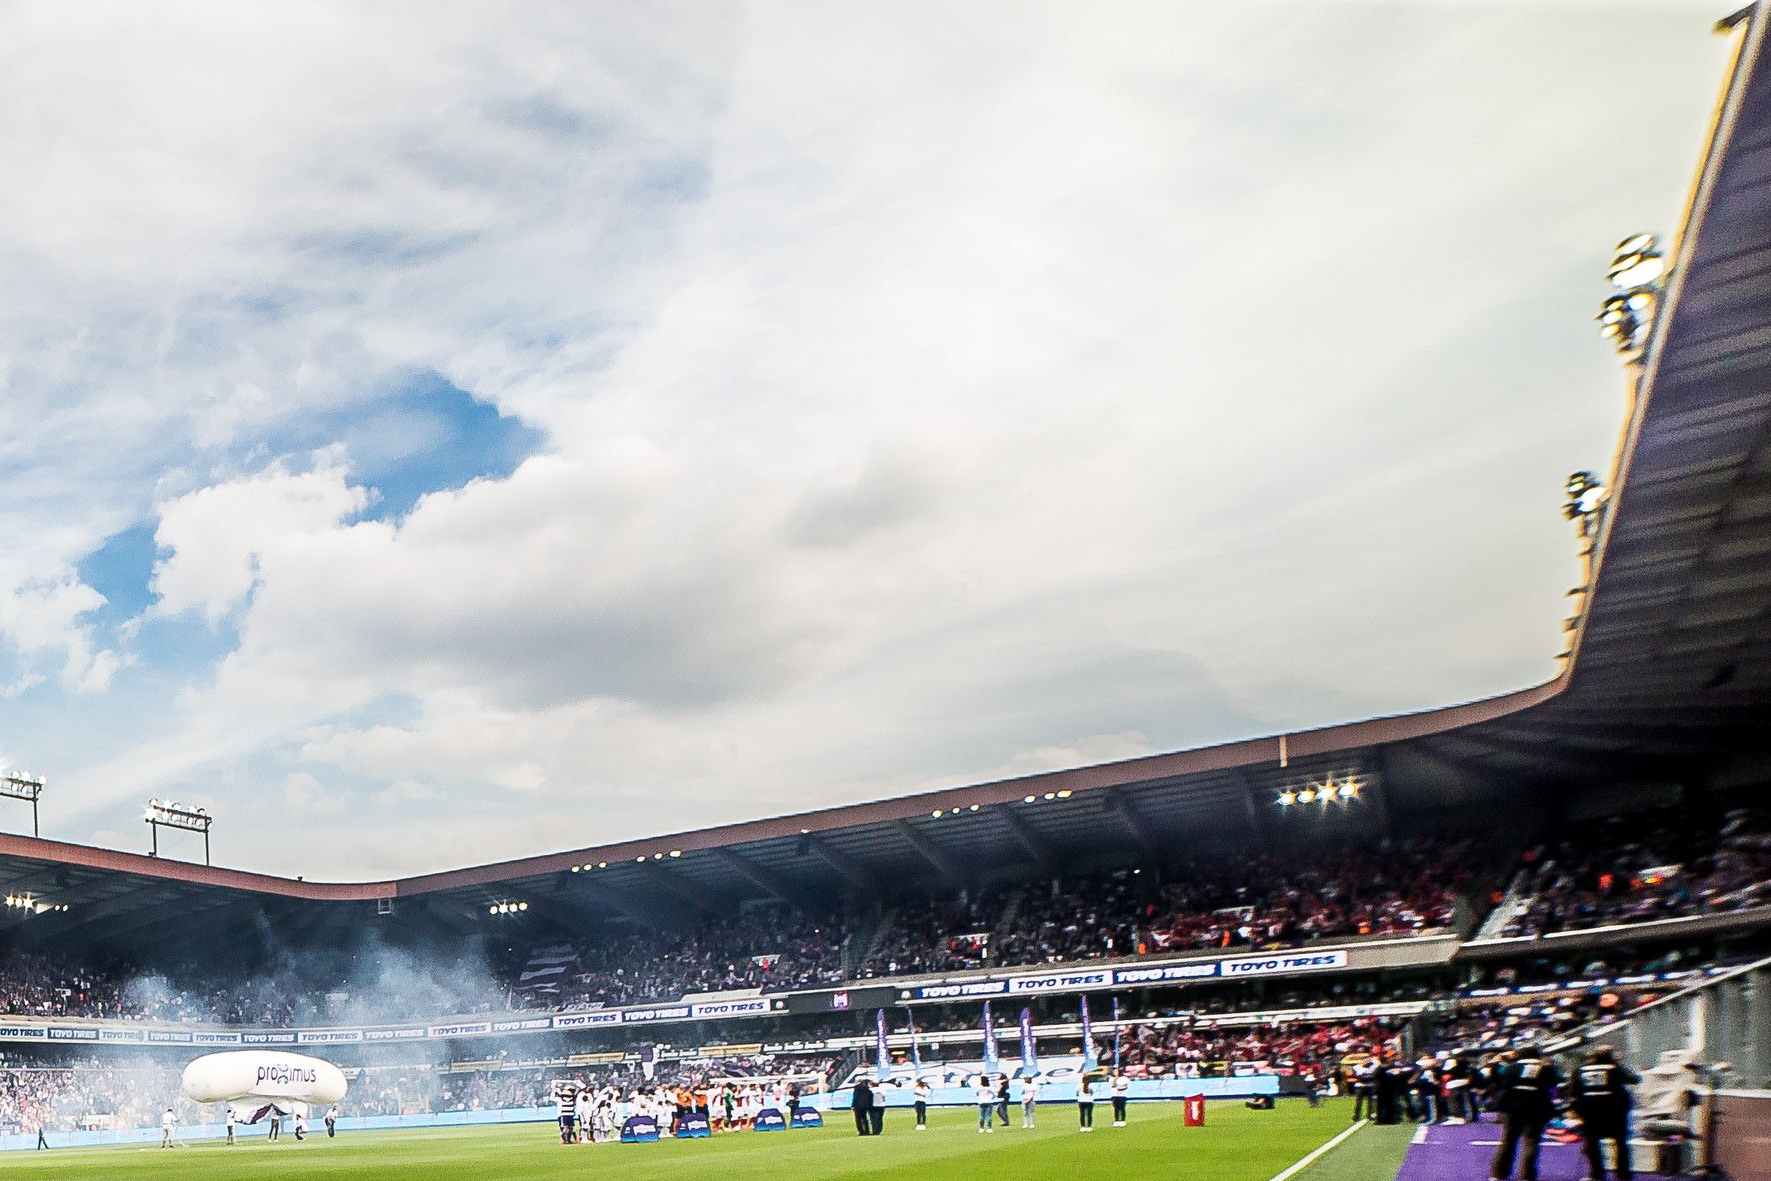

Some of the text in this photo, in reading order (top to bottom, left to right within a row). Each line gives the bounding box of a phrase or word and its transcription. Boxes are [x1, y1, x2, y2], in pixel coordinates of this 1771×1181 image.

[1231, 955, 1336, 973] TOYO TIRES
[1116, 968, 1164, 982] TOYO
[1018, 974, 1104, 989] TOYO TIRES
[921, 984, 960, 998] TOYO
[698, 1002, 764, 1014] TOYO TIRES
[558, 1014, 617, 1025] TOYO TIRES
[624, 1010, 654, 1021] TOYO
[432, 1025, 487, 1035] TOYO TIRES
[493, 1022, 521, 1031] TOYO
[19, 1028, 44, 1037] TIRES
[50, 1029, 97, 1039] TOYO TIRES
[102, 1031, 123, 1039] TOYO
[150, 1032, 169, 1041] TOYO
[243, 1033, 267, 1042] TOYO
[301, 1033, 358, 1041] TOYO TIRES
[365, 1031, 393, 1039] TOYO
[195, 1034, 237, 1042] TOYO TIRES
[256, 1064, 317, 1086] proximus
